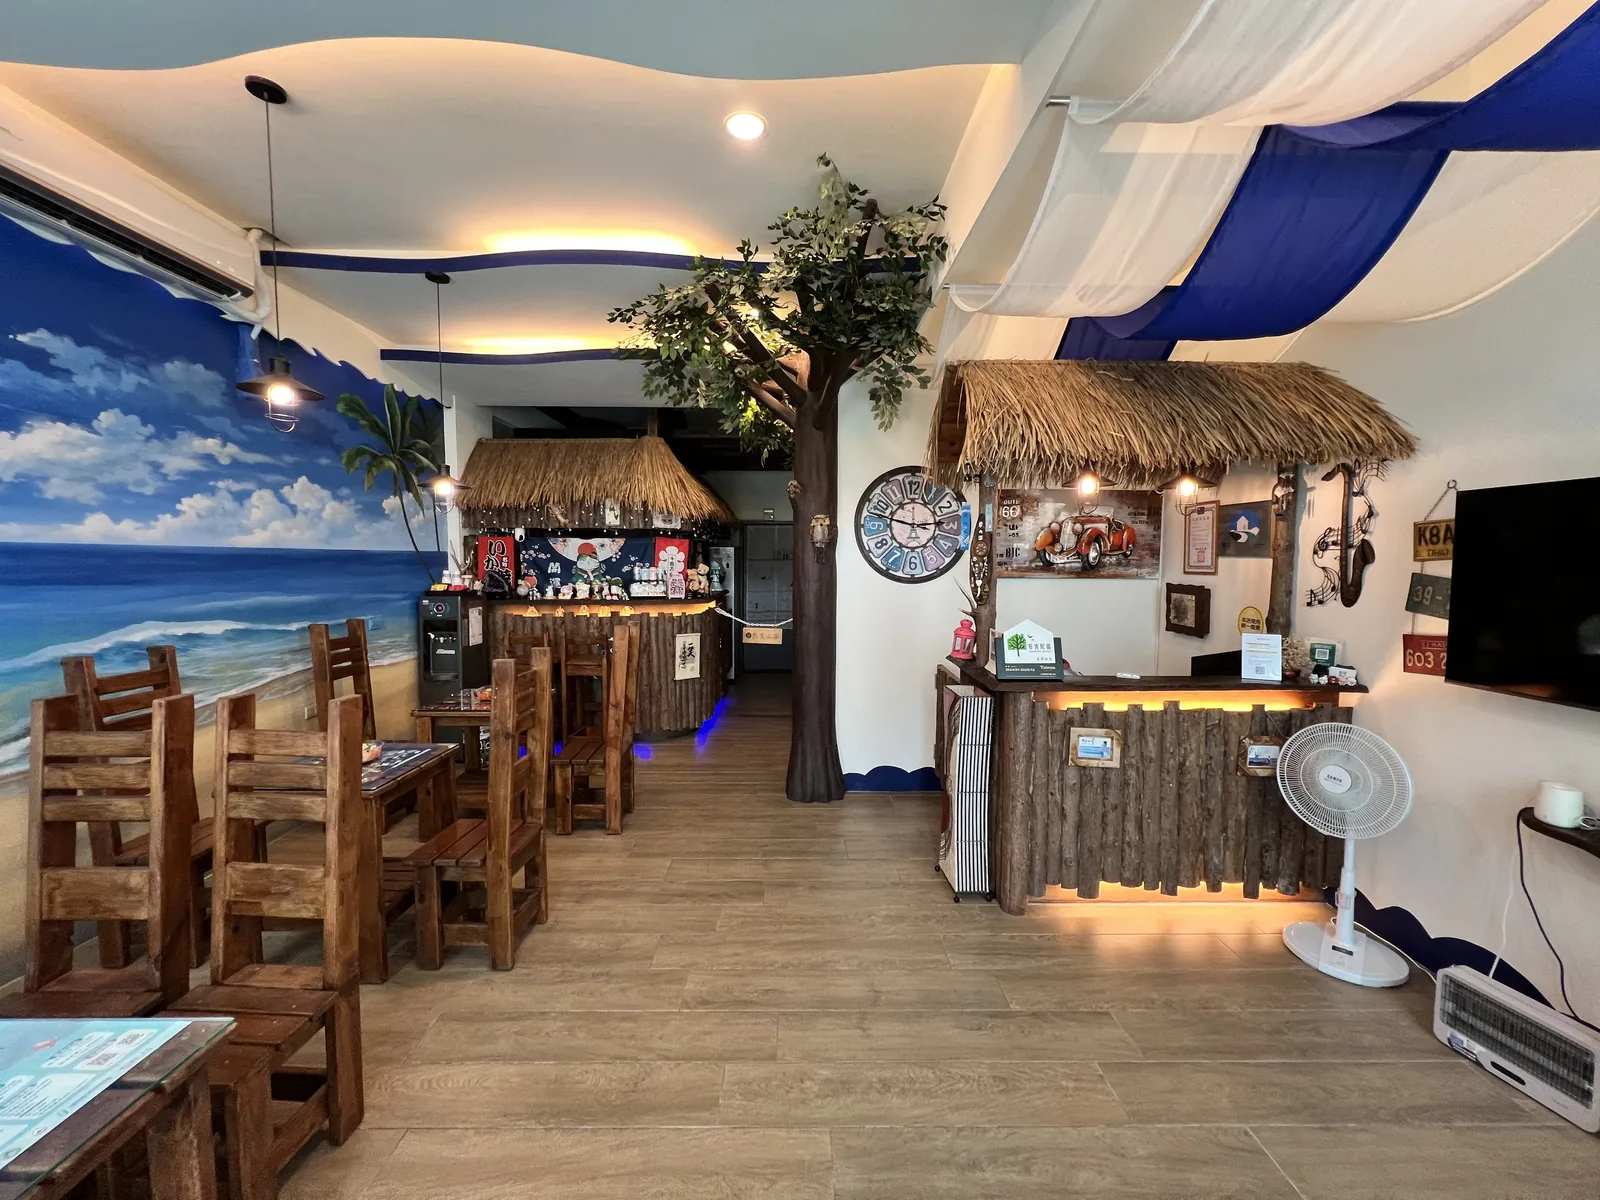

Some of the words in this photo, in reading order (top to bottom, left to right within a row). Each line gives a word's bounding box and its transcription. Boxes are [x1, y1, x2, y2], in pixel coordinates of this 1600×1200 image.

[907, 480, 920, 496] 12
[873, 500, 890, 515] 10
[938, 501, 952, 514] 2
[1002, 506, 1019, 518] 66
[869, 521, 884, 530] 9
[943, 521, 958, 530] 3
[875, 538, 888, 549] 8
[938, 539, 952, 550] 4
[888, 550, 901, 563] 7
[908, 556, 918, 570] 6
[925, 549, 938, 564] 5
[1405, 648, 1434, 669] 603
